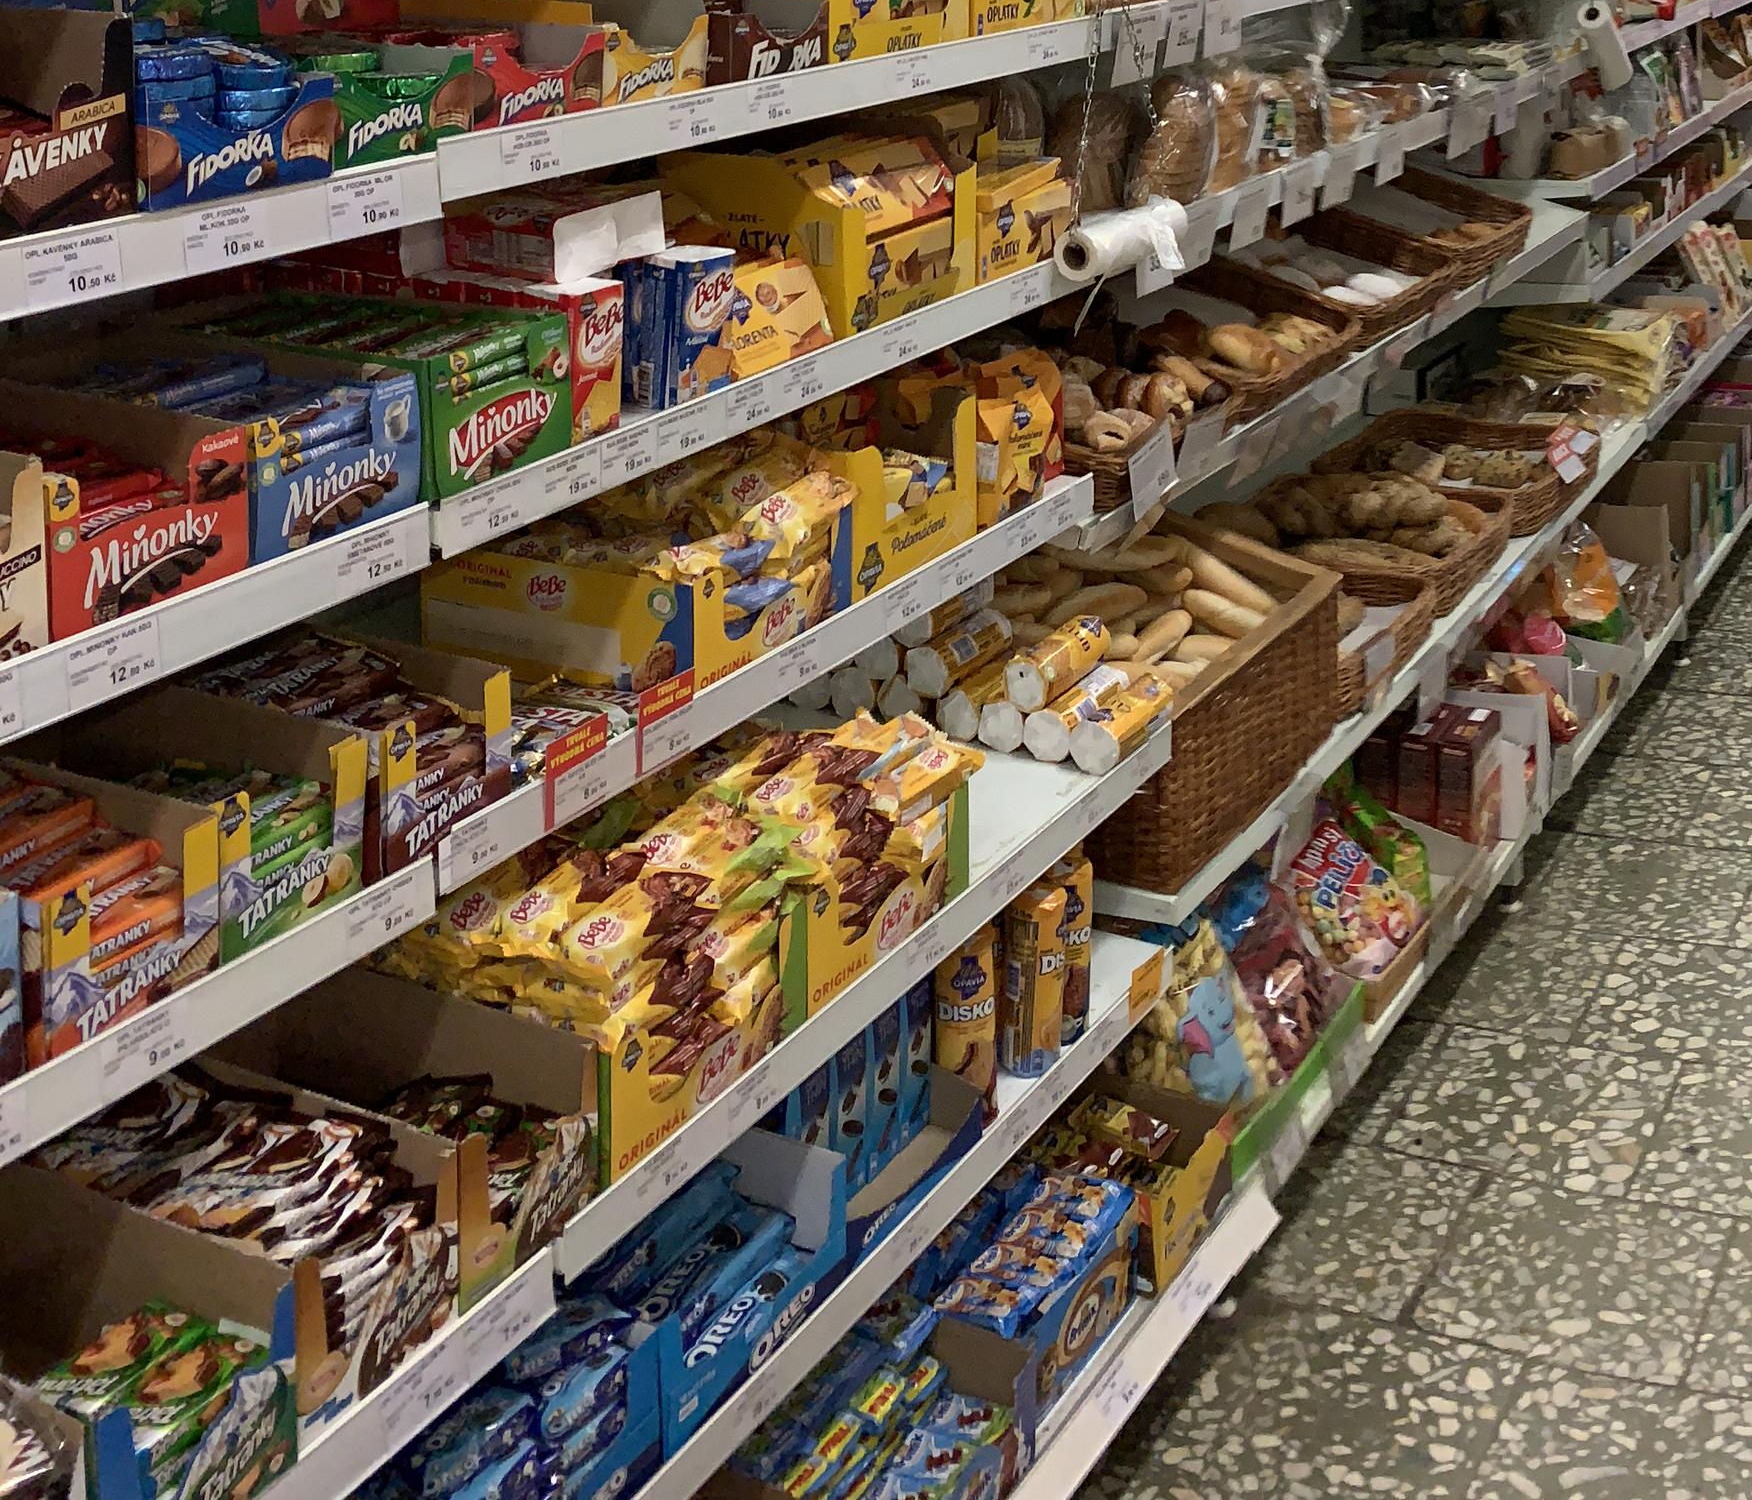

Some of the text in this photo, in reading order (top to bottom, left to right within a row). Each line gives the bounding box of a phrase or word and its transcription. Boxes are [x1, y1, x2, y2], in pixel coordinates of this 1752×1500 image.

[617, 57, 676, 104] FIDORKA
[748, 34, 822, 81] FIDRKA
[70, 100, 118, 124] ARABICA
[500, 76, 565, 126] FIDORKA
[347, 102, 423, 160] FIDORKA
[0, 124, 109, 188] ÁVENKY
[186, 129, 275, 198] FIDORKA
[104, 272, 117, 284] Kč
[694, 271, 734, 312] BeBe
[200, 433, 240, 454] Kakaové
[528, 574, 567, 596] BeBe
[405, 782, 484, 857] TATRANKY
[237, 849, 332, 940] TATRANKY
[577, 915, 612, 949] BeBe
[75, 948, 184, 1042] TATRANKY
[952, 972, 986, 989] OPAVIA
[937, 995, 995, 1021] DISKO
[682, 1294, 756, 1370] OREO
[748, 1282, 816, 1376] OREO
